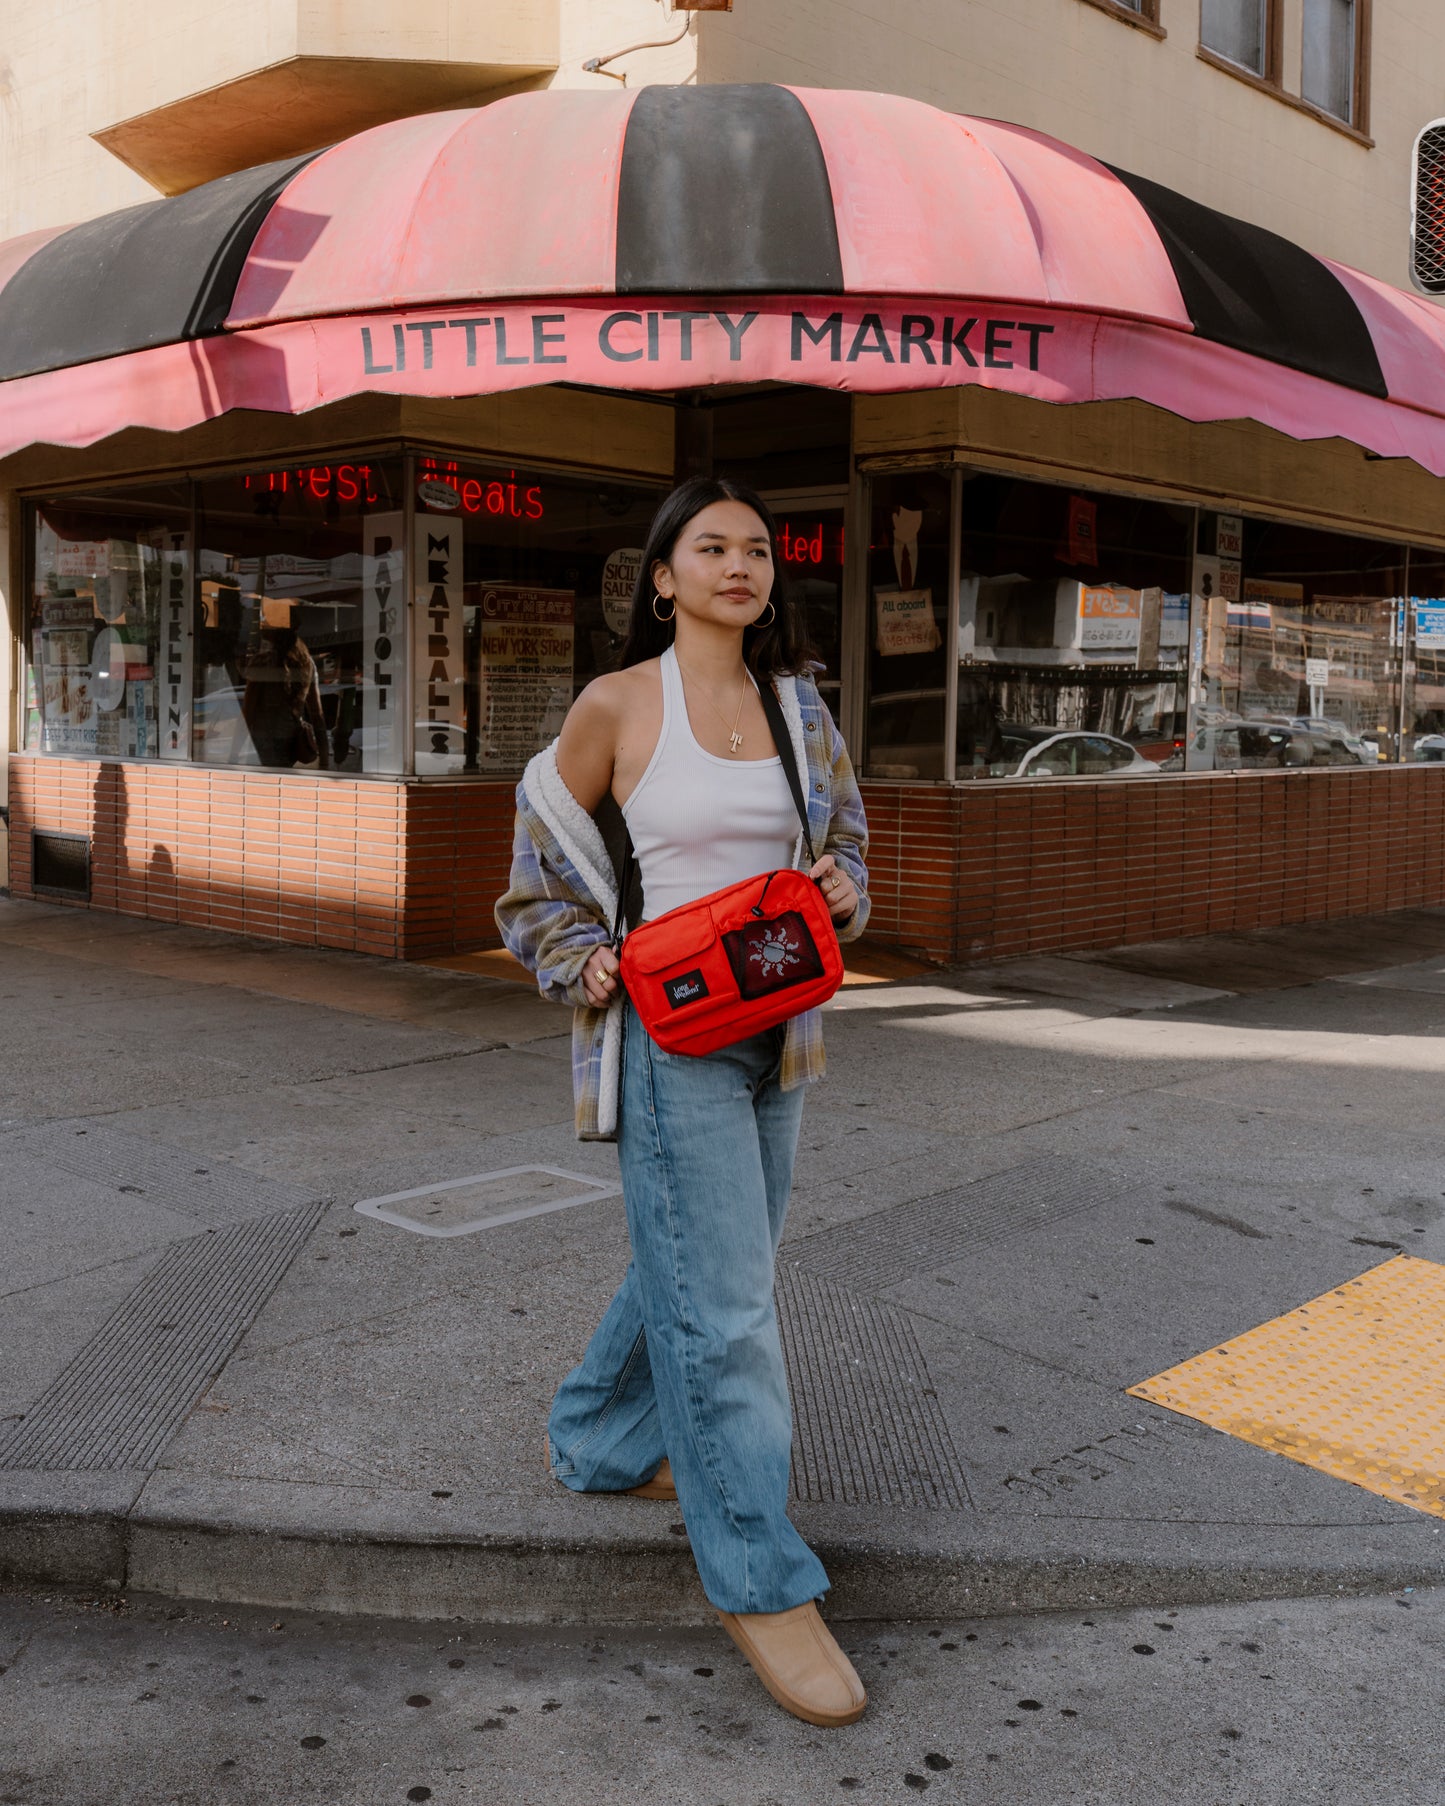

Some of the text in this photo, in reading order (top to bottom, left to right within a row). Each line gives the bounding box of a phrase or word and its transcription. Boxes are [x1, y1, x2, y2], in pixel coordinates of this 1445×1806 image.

[361, 311, 1054, 375] LITTLE CITY MARKET
[1218, 533, 1240, 552] PORK
[522, 600, 572, 616] MEATS
[882, 598, 926, 613] All aboard
[374, 536, 393, 711] RAVIOLI
[501, 626, 554, 637] THE MAJESTIC
[167, 535, 185, 750] TORTELLINI
[427, 532, 450, 754] MEATBALLS
[482, 636, 572, 657] NEW YORK STRIP
[483, 664, 491, 673] IN
